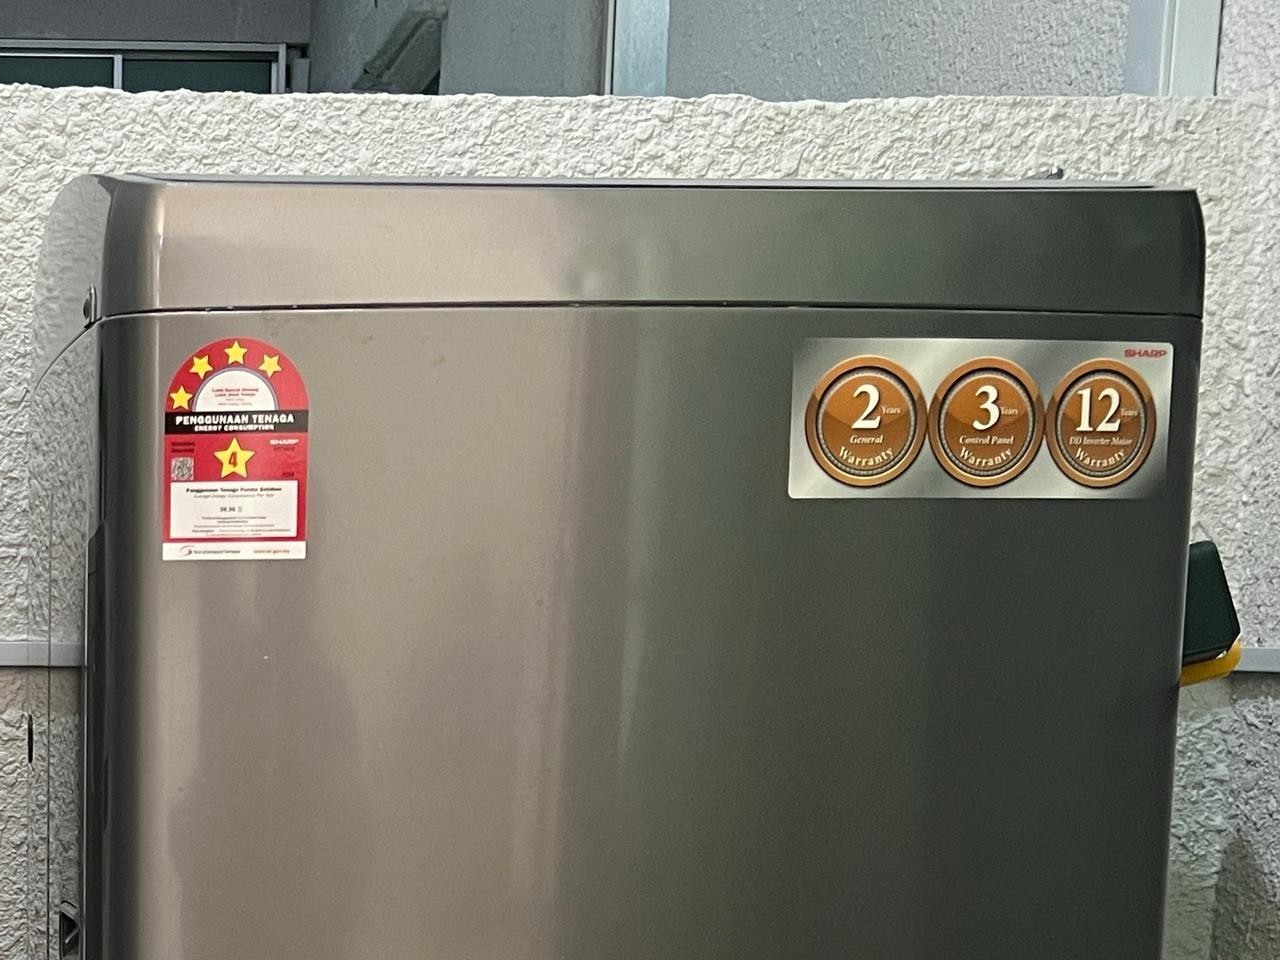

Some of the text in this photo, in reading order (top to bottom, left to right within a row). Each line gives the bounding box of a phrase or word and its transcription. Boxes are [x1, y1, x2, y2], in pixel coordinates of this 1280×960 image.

[1124, 350, 1168, 358] SHARP
[851, 384, 901, 429] 2 Years
[972, 385, 1019, 431] 3 Years
[1076, 387, 1138, 432] 12 Years
[175, 414, 294, 426] PENGGUNAAN TENAGA
[850, 435, 883, 445] General
[959, 436, 1013, 445] Control Panel
[1069, 437, 1081, 445] DD
[1082, 437, 1110, 445] Inverter
[228, 451, 238, 468] 4
[838, 446, 894, 467] Warranty
[959, 447, 1012, 467] Warranty
[1074, 448, 1126, 467] Warranty
